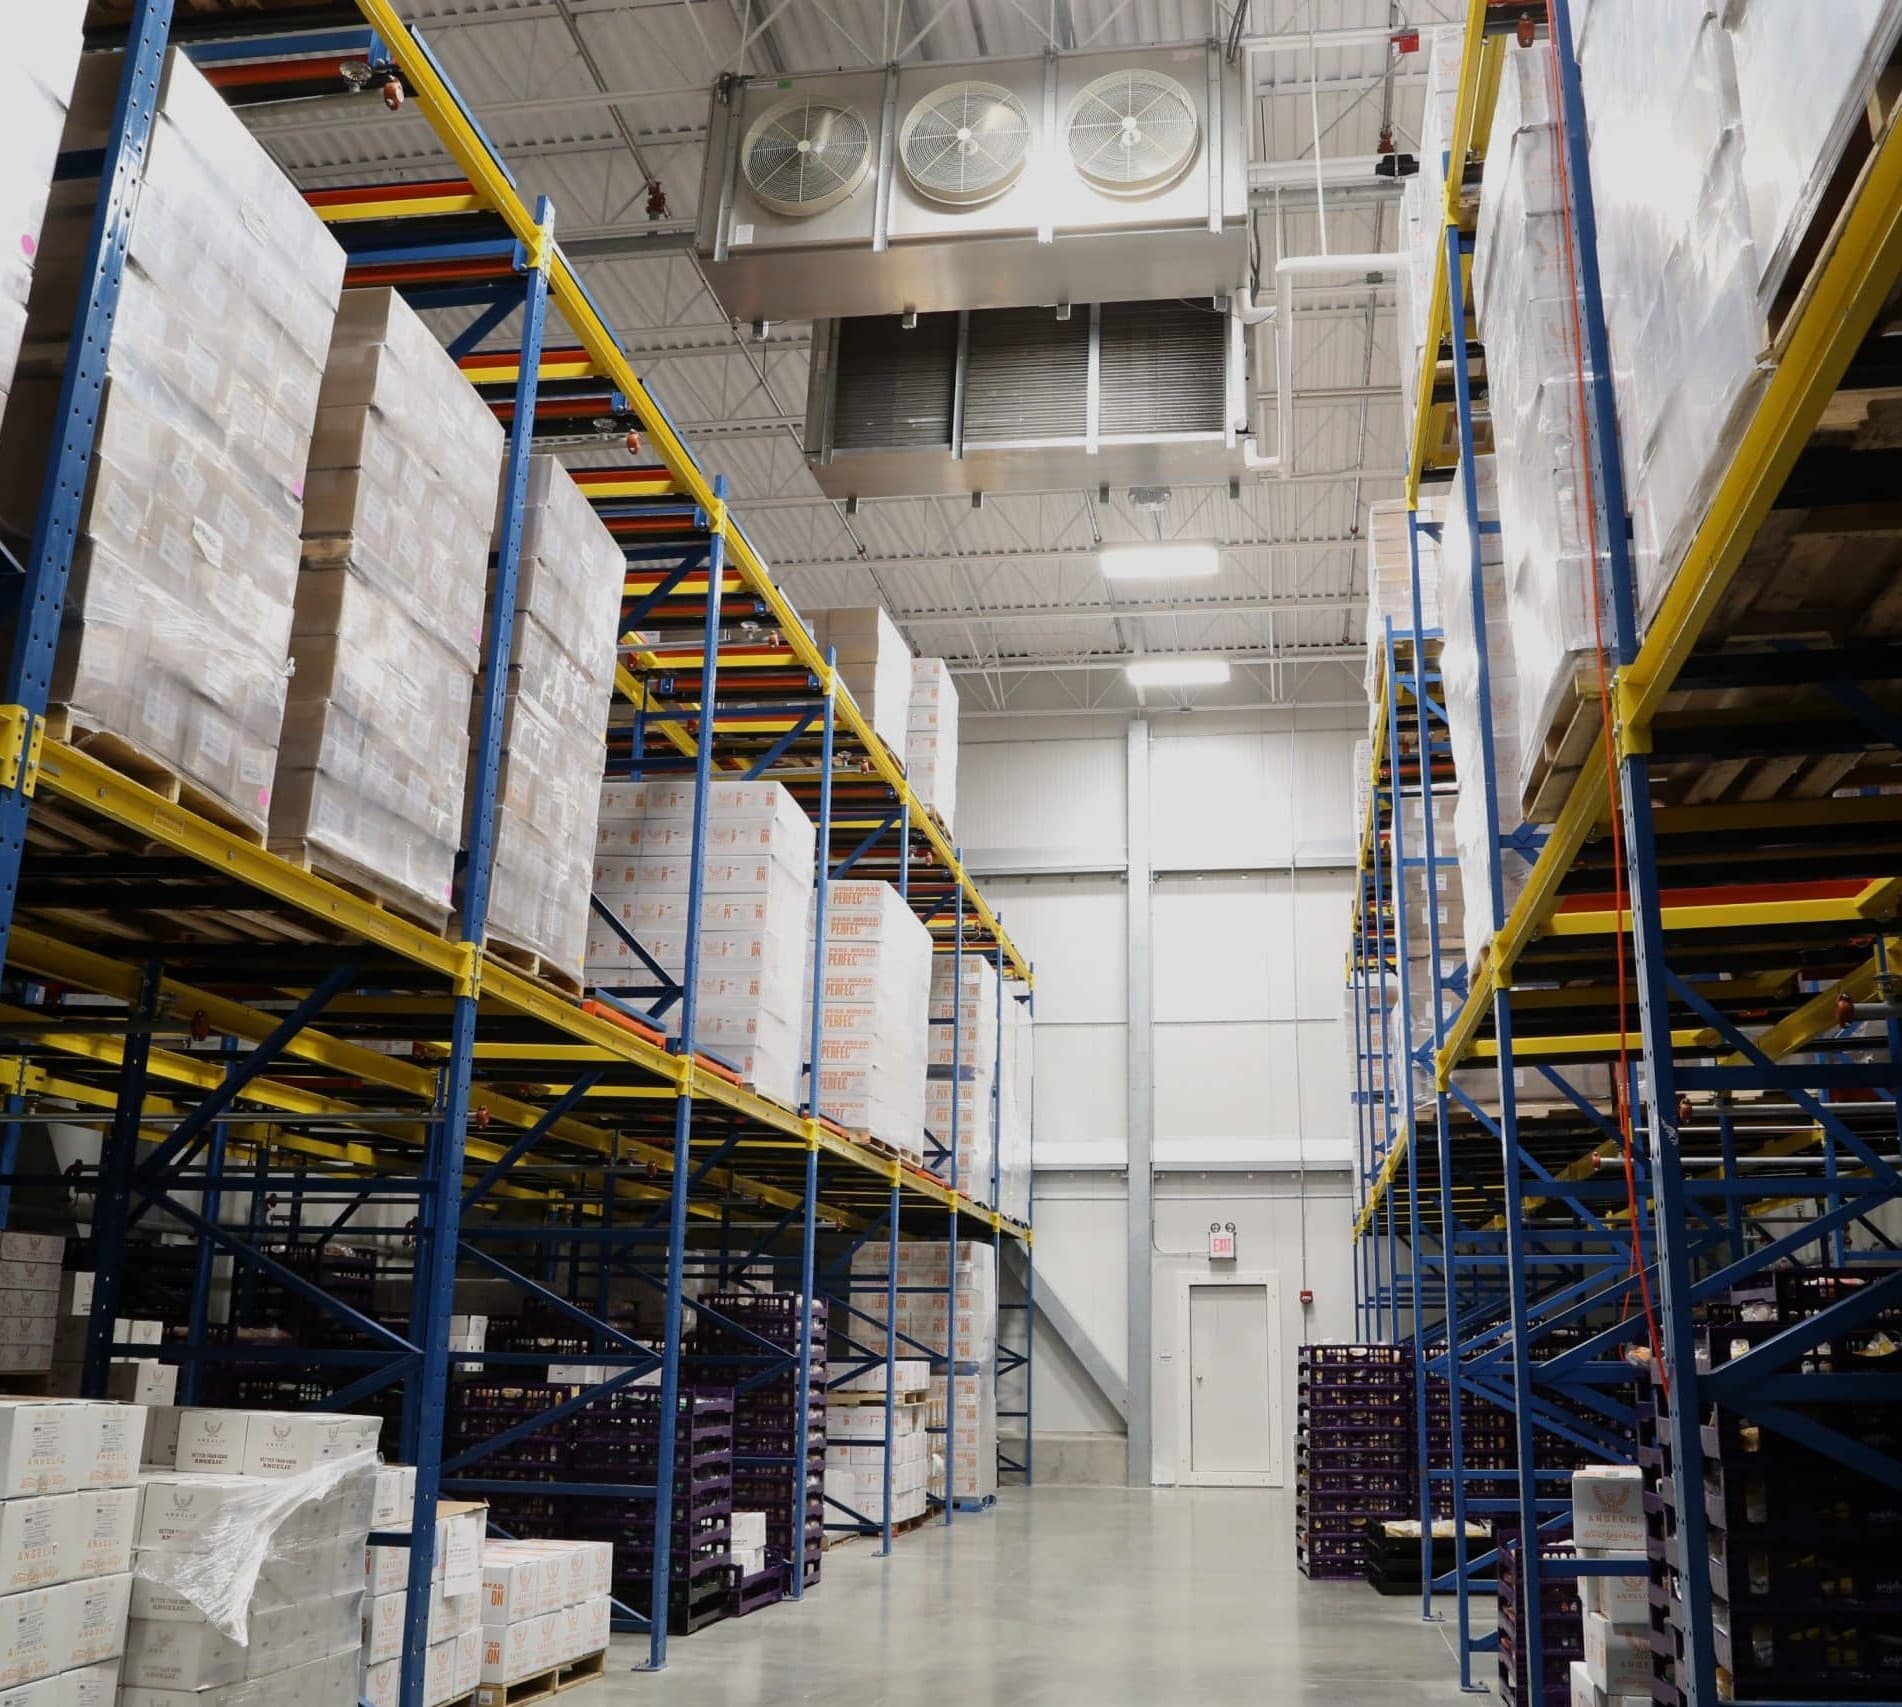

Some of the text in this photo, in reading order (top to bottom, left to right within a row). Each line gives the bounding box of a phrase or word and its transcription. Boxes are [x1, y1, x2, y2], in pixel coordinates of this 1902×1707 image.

[833, 892, 873, 904] PERFEC
[831, 922, 870, 935] PERFEC
[828, 954, 867, 966] PERFEC
[825, 984, 864, 996] PERFEC
[1213, 1238, 1232, 1252] EXIT
